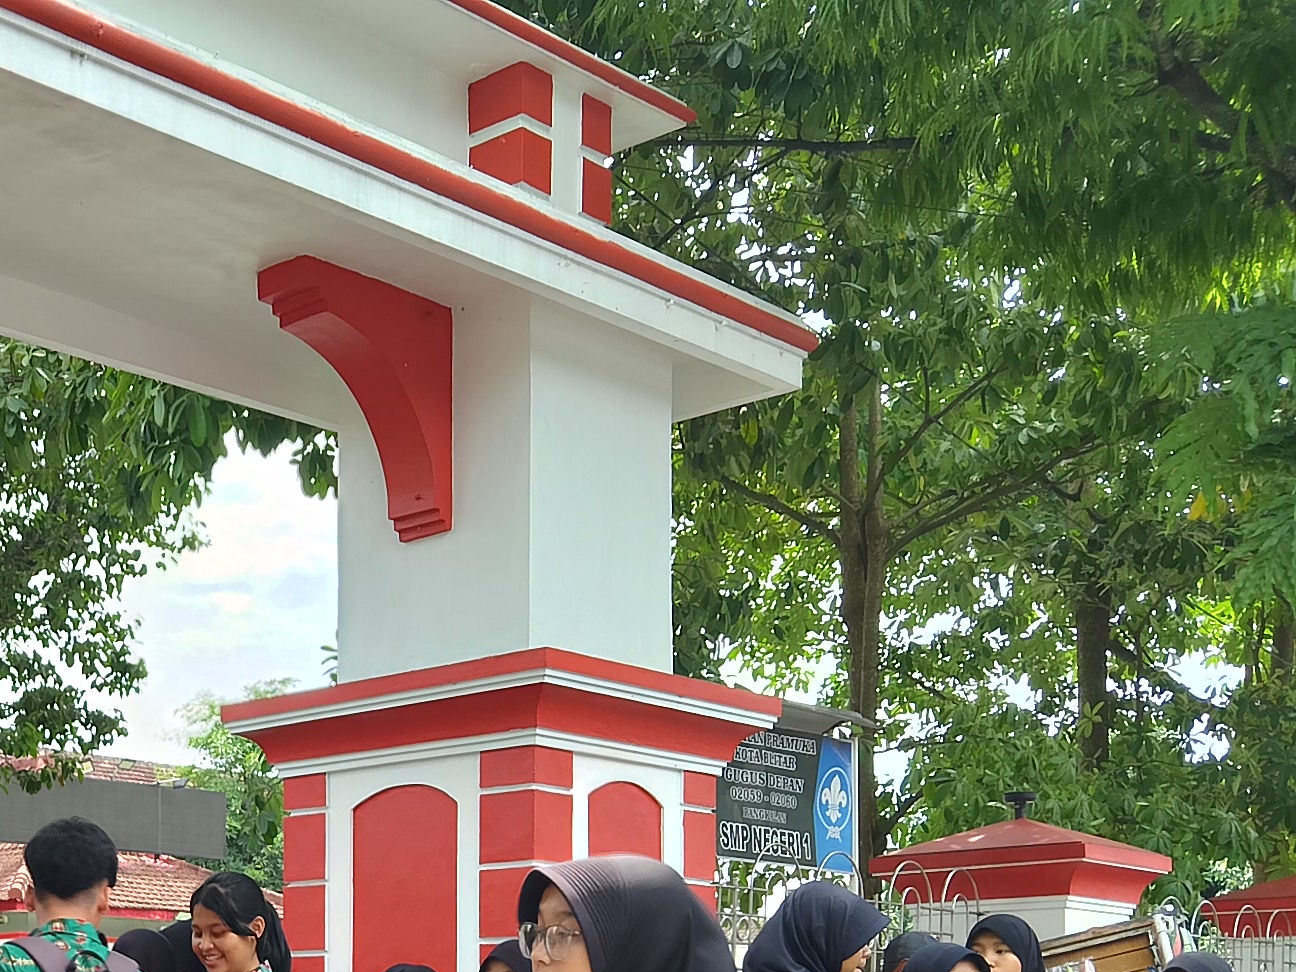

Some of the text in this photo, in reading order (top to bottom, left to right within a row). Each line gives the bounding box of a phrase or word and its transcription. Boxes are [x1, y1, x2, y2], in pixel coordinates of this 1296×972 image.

[765, 732, 817, 755] PRAMUKA
[734, 746, 797, 770] KOTA BLITAR
[724, 767, 804, 793] GUGUS DEPAN
[730, 786, 763, 803] 02059
[770, 791, 798, 809] 02060
[720, 821, 811, 860] SMP NEGERI 1
